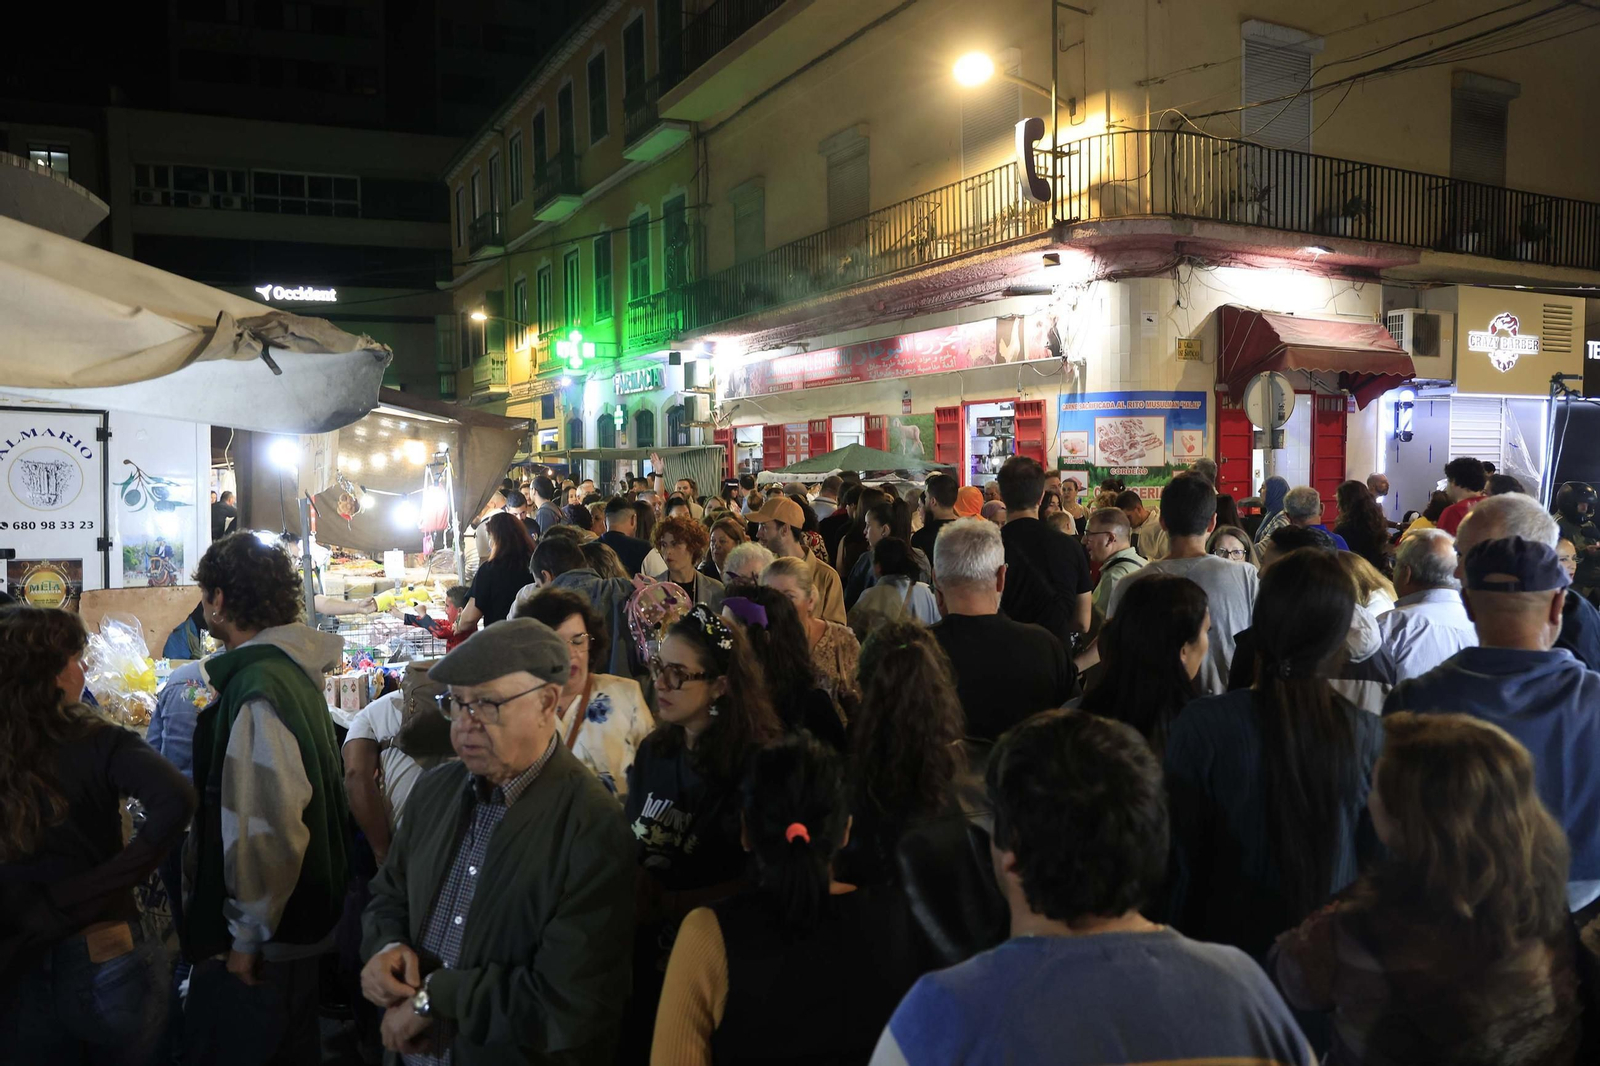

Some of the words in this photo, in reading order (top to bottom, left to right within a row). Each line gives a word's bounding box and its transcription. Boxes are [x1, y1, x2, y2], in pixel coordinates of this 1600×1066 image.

[273, 286, 337, 301] Occident
[1470, 335, 1498, 347] CRAZY
[1502, 337, 1539, 350] BARBER
[13, 521, 36, 530] 680
[40, 521, 55, 530] 98
[60, 521, 75, 530] 33
[79, 521, 94, 529] 23
